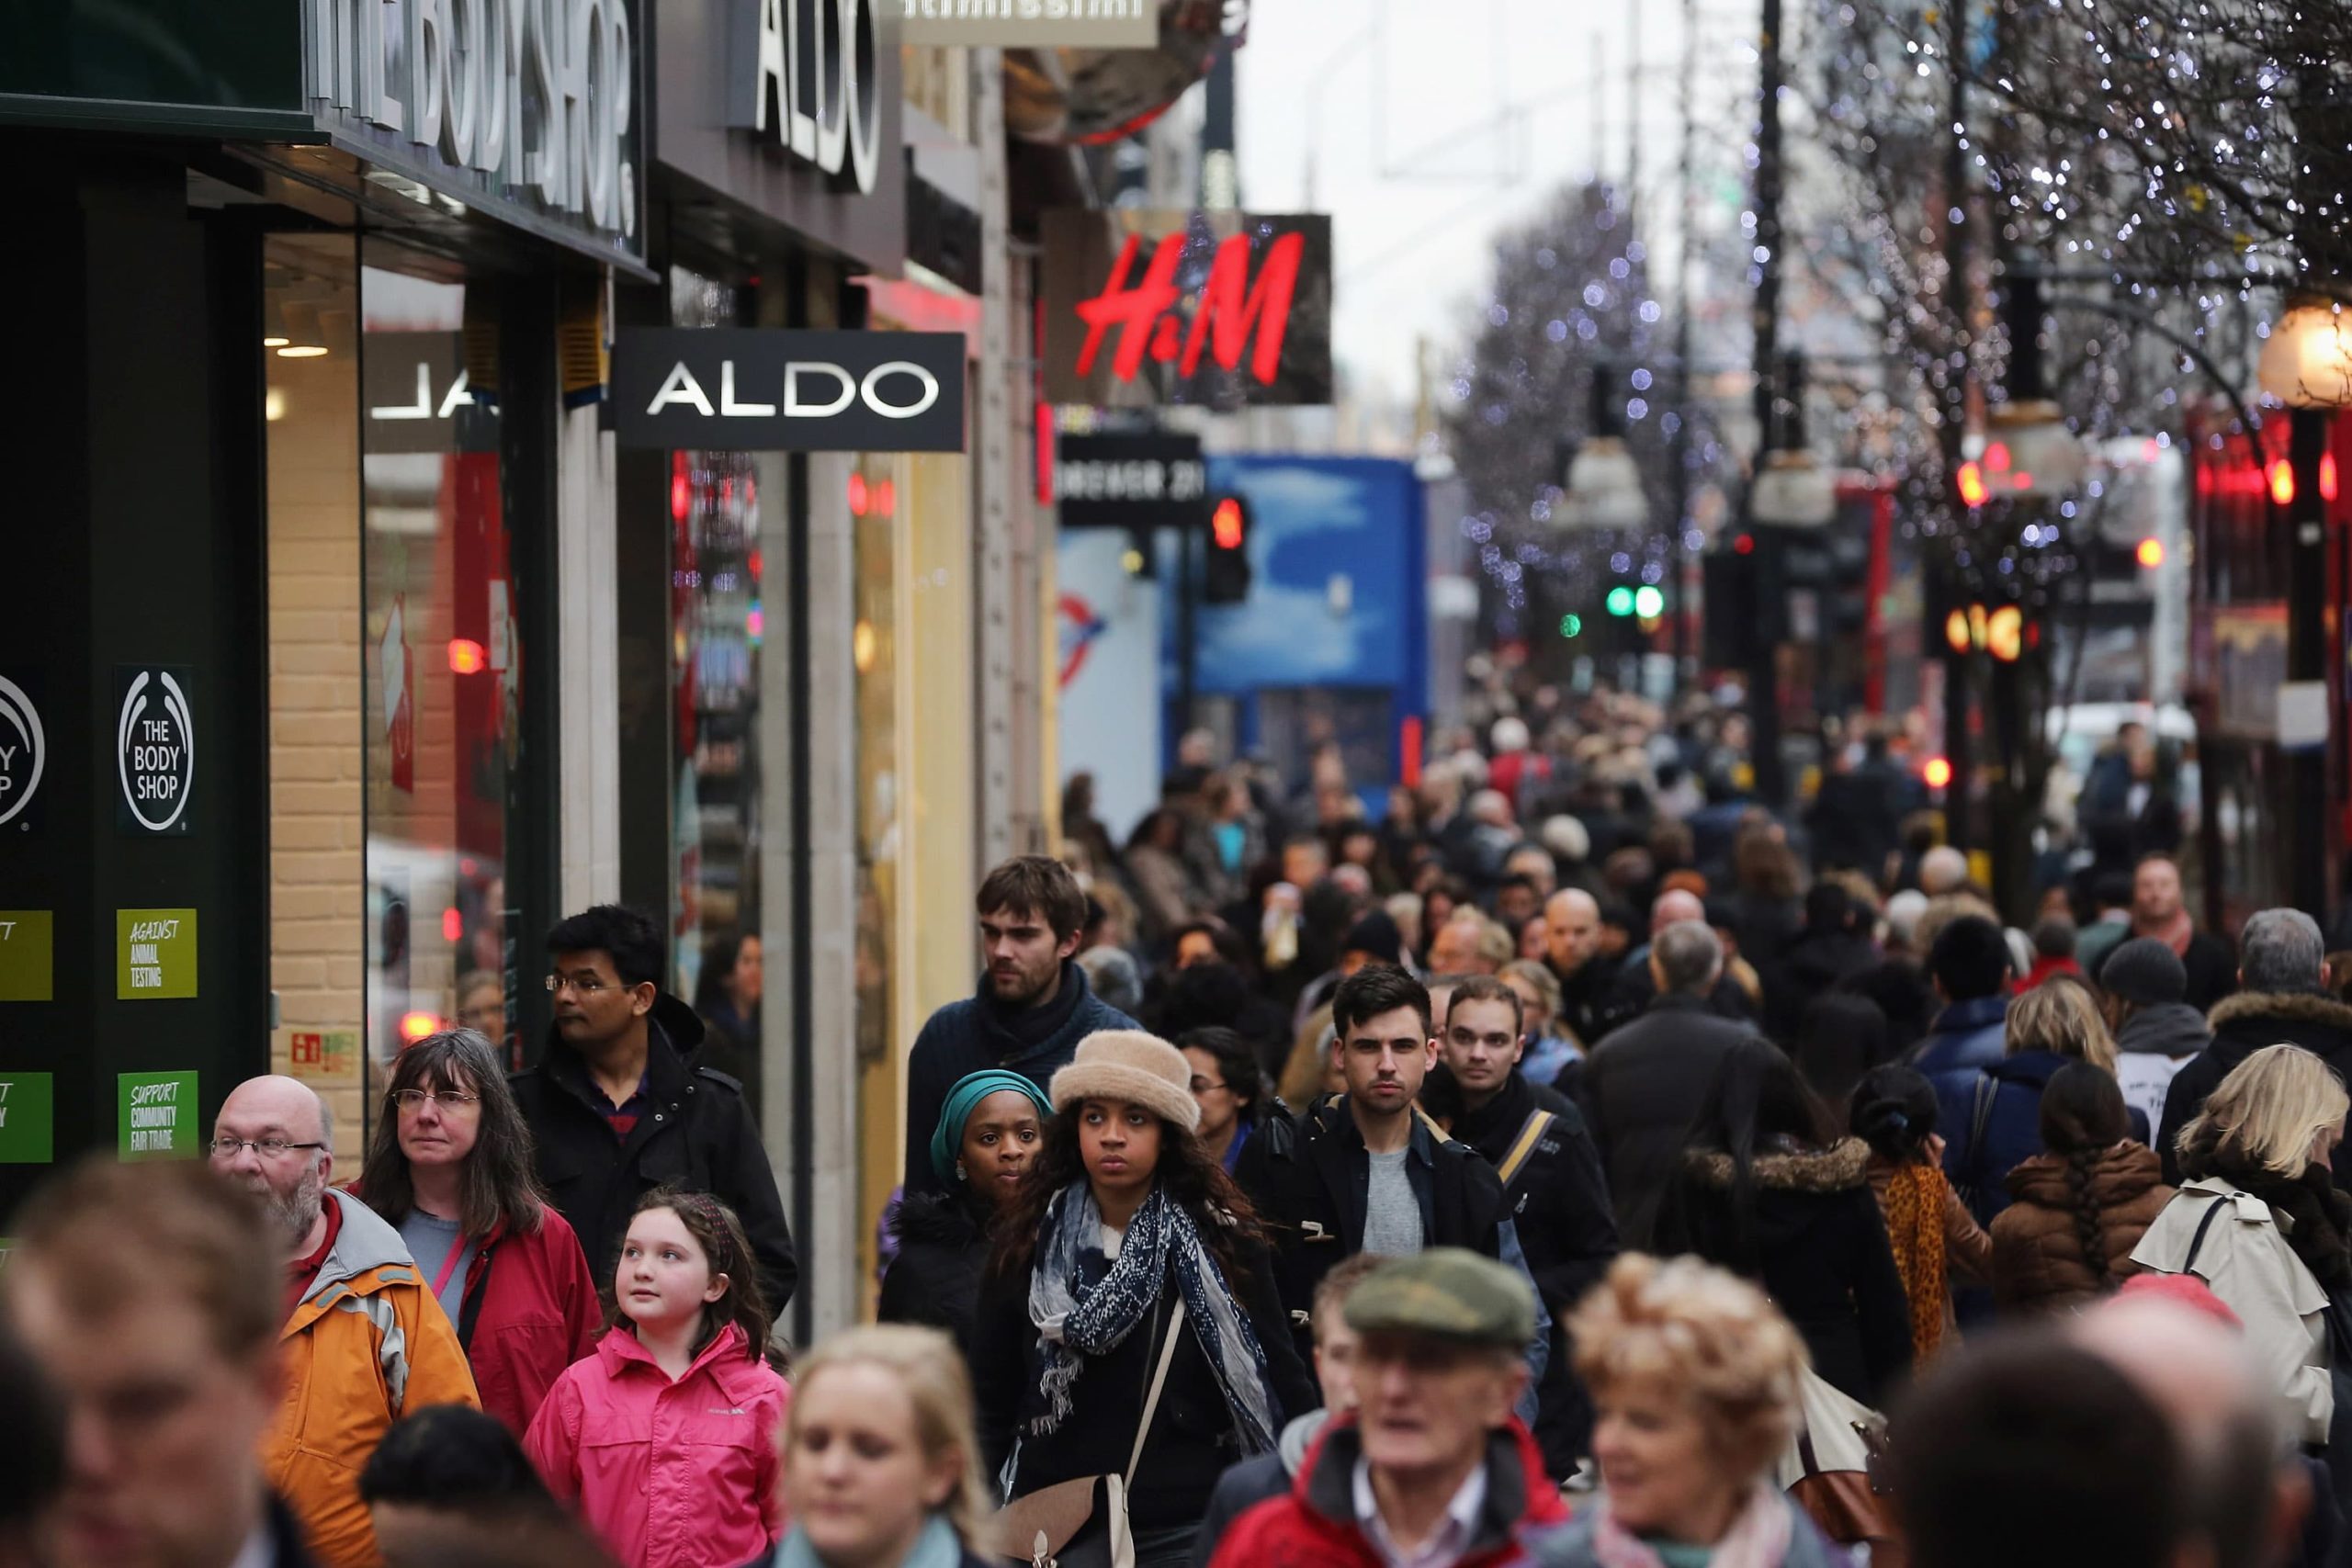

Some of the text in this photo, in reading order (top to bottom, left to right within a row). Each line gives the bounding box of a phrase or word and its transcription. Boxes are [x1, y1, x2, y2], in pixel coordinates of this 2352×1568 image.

[756, 0, 882, 196] ALDO
[1075, 231, 1306, 387] H&M
[647, 360, 939, 419] ALDO
[142, 720, 169, 741] THE
[134, 746, 179, 771] BODY
[138, 775, 178, 799] SHOP
[130, 919, 179, 942] AGAINST
[130, 943, 159, 964] ANIMAL
[130, 966, 162, 987] TESTING
[130, 1082, 180, 1106] SUPPORT
[130, 1106, 176, 1128] COMMUNITY
[131, 1130, 173, 1151] FAIR TRADE
